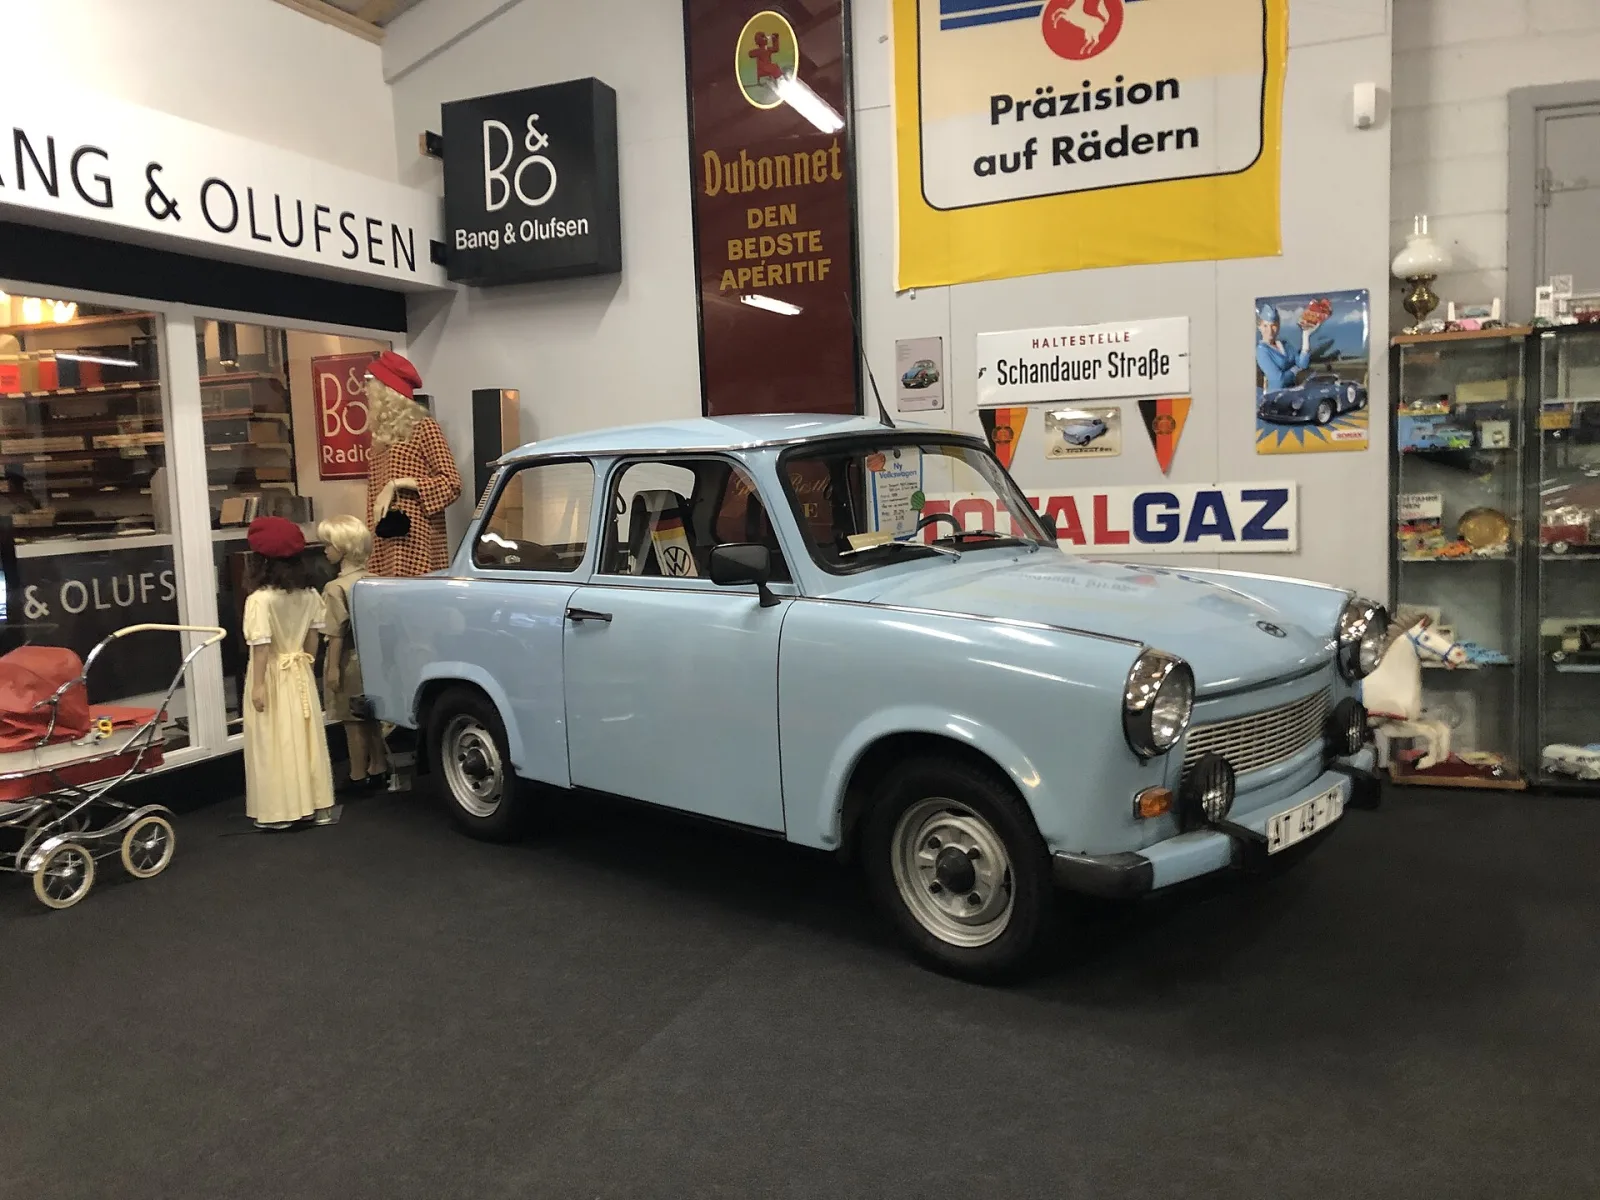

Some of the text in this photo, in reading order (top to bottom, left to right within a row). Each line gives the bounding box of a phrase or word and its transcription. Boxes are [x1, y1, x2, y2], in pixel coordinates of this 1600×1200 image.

[990, 74, 1180, 126] Präzision
[703, 137, 843, 197] Dubonnet
[973, 124, 1200, 177] auf Rädern
[0, 127, 416, 272] NG & OLUFSEN
[747, 203, 797, 230] DEN
[455, 217, 589, 250] Bang & Olufsen
[728, 230, 824, 261] BEDSTE
[719, 258, 832, 291] APÉRITIF
[1032, 331, 1131, 349] HALTESTELLE
[997, 348, 1170, 385] Schandauer Straße
[879, 470, 917, 479] Volkswagen
[893, 463, 903, 471] Ny
[24, 585, 50, 620] &
